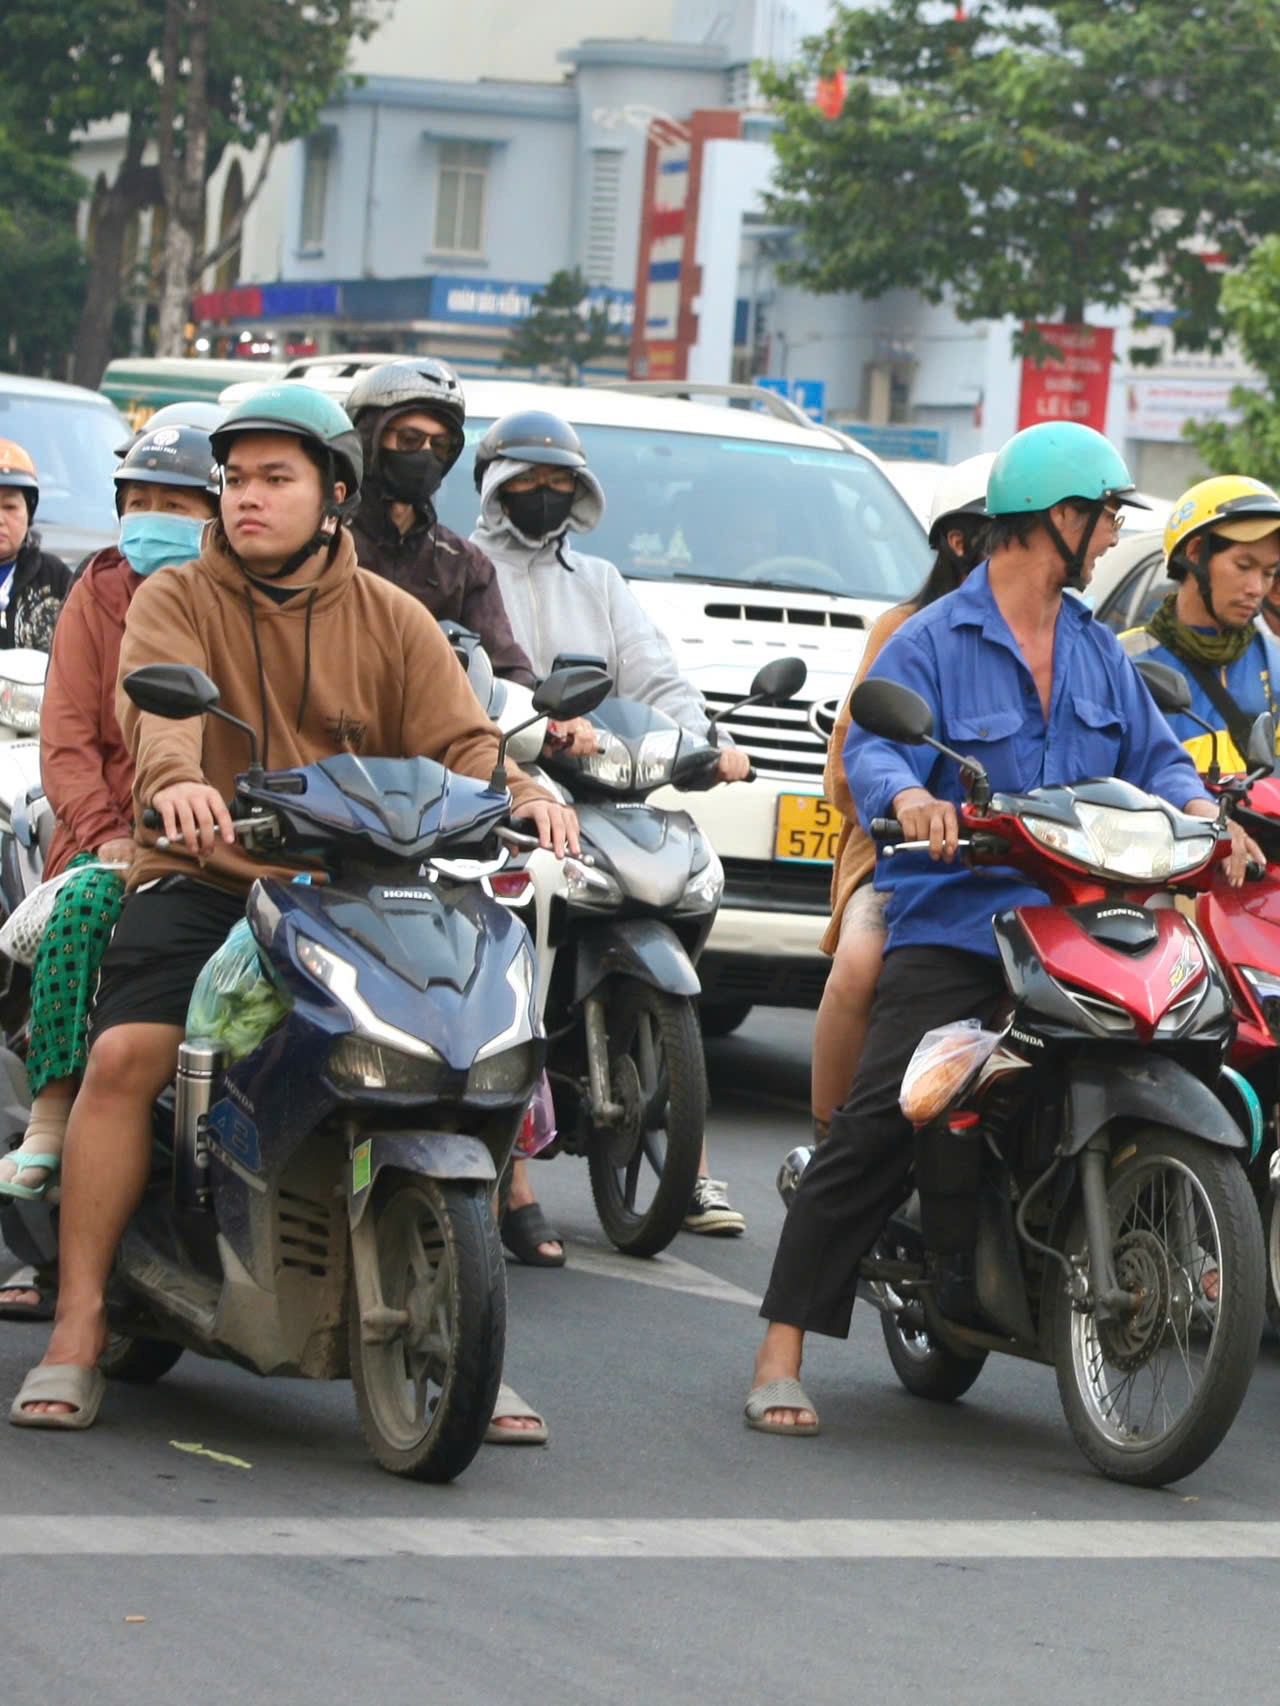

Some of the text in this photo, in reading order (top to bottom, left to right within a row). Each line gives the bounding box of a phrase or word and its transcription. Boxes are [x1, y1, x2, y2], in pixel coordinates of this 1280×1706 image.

[815, 800, 831, 826] 5
[383, 890, 433, 901] HONDA
[1096, 908, 1145, 919] HONDA
[1011, 1028, 1045, 1048] HONDA
[224, 1075, 255, 1113] HONDA
